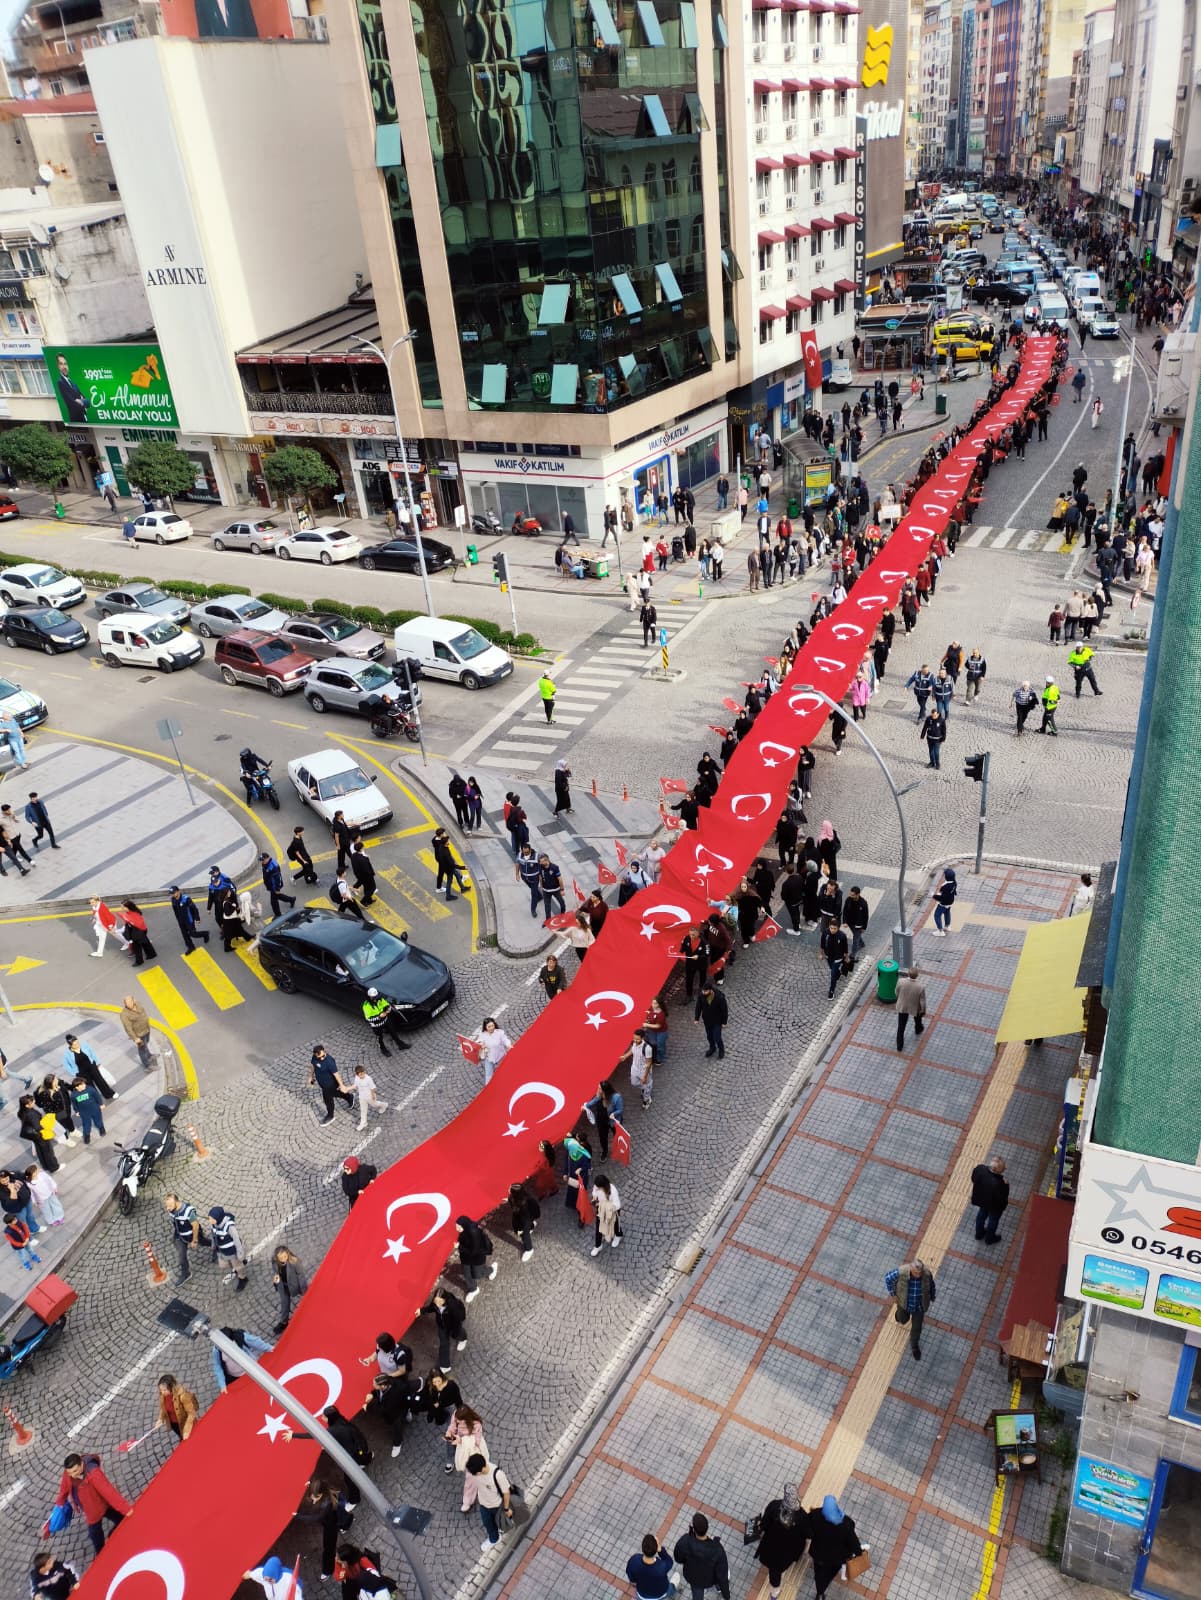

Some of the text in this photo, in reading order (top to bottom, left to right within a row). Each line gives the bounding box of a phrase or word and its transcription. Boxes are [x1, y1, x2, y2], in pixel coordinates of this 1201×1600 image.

[147, 267, 206, 286] ARMINE
[89, 385, 106, 407] Ev
[97, 410, 172, 422] EN KOLAY YOLU
[648, 424, 689, 451] VAKIF KATILIM
[362, 461, 381, 471] ADG
[494, 459, 565, 472] VAKIF KATILIM
[1131, 1235, 1201, 1265] 0546
